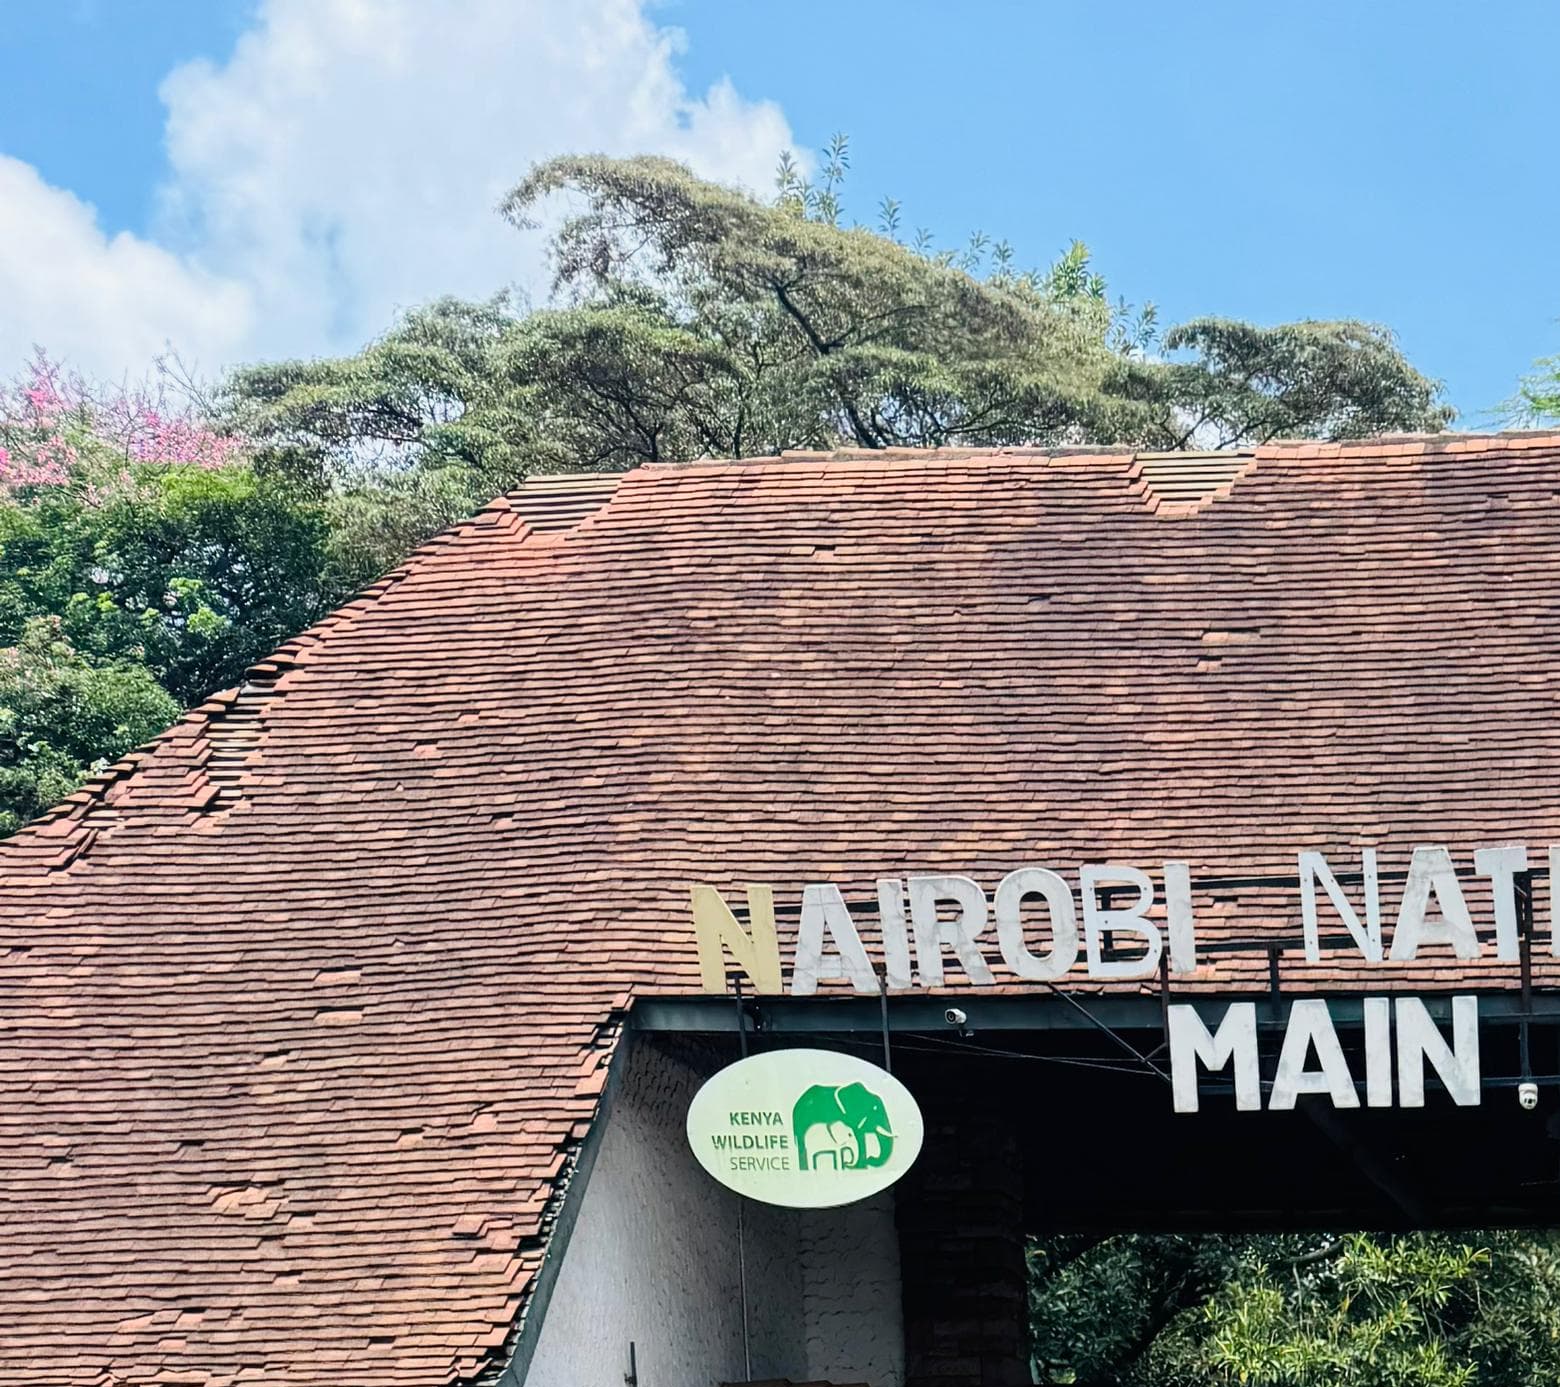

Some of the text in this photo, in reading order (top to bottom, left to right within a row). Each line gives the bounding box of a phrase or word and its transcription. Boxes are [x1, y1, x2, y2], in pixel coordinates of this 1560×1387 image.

[689, 860, 1197, 996] NAIROBI
[1167, 996, 1482, 1114] MAIN
[729, 1111, 784, 1126] KENYA
[711, 1134, 789, 1150] WILDLIFE
[730, 1156, 790, 1171] SERVICE
